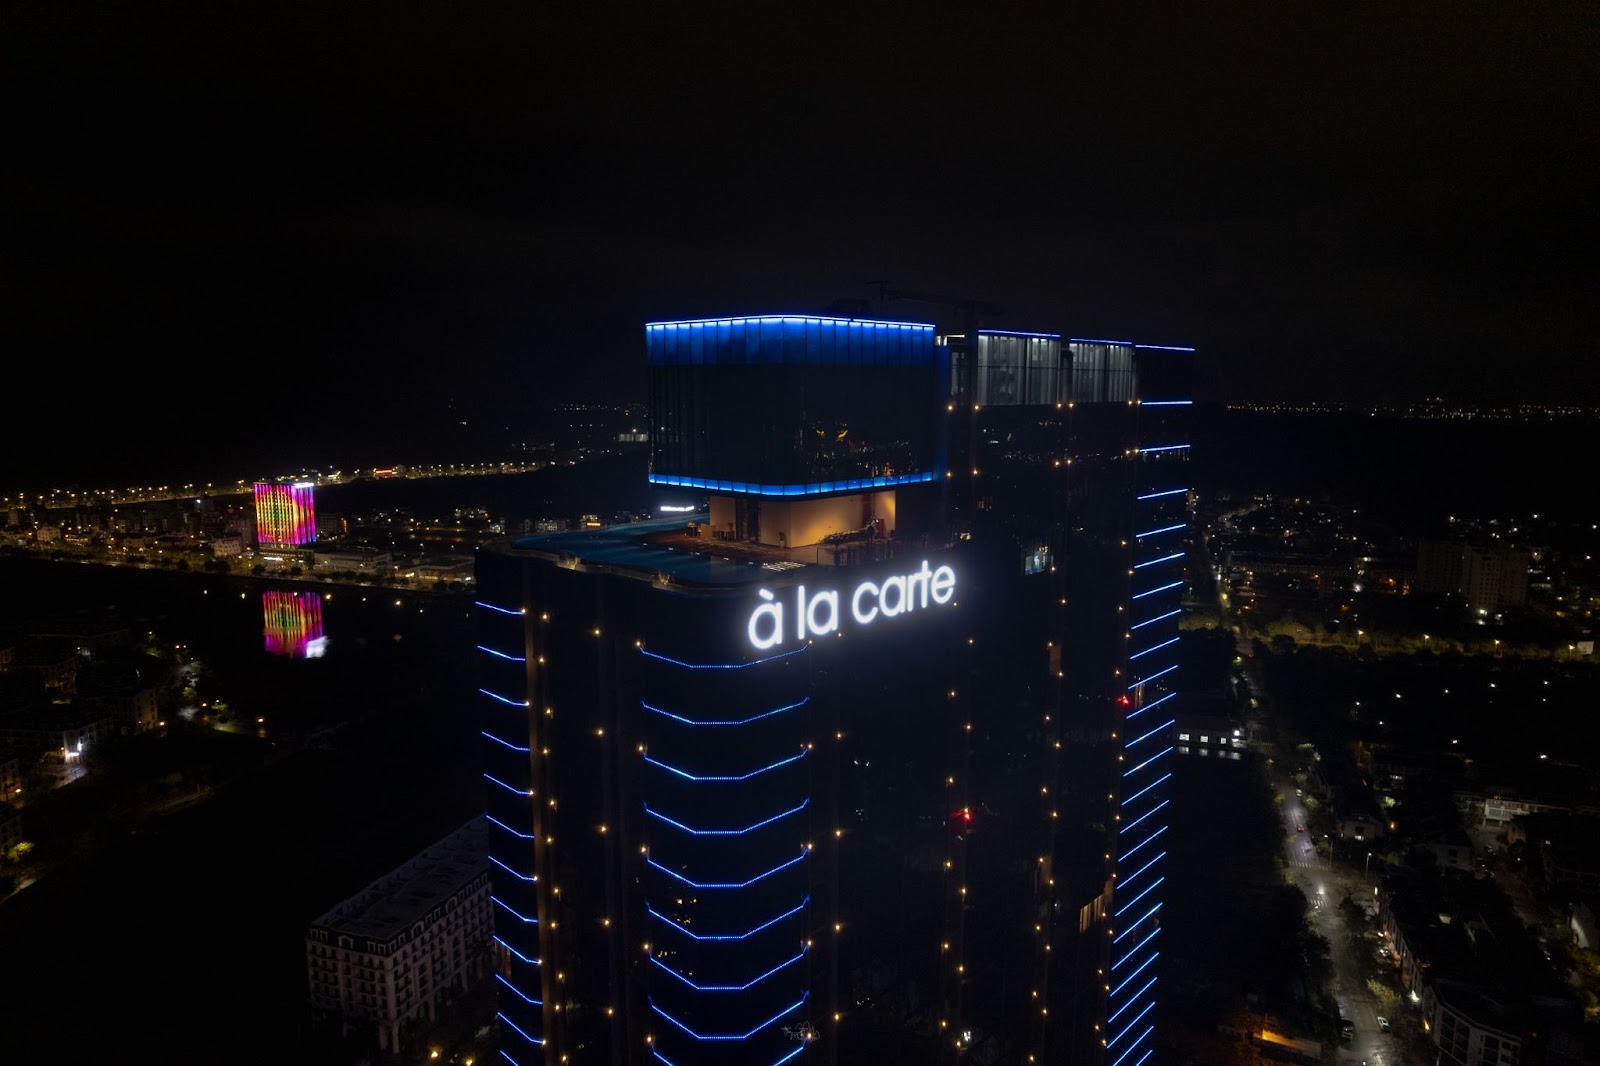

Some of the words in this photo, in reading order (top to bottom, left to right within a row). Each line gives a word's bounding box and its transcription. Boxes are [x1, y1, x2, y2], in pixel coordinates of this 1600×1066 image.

[748, 588, 783, 649] à
[798, 585, 838, 639] la
[852, 560, 956, 624] carte
